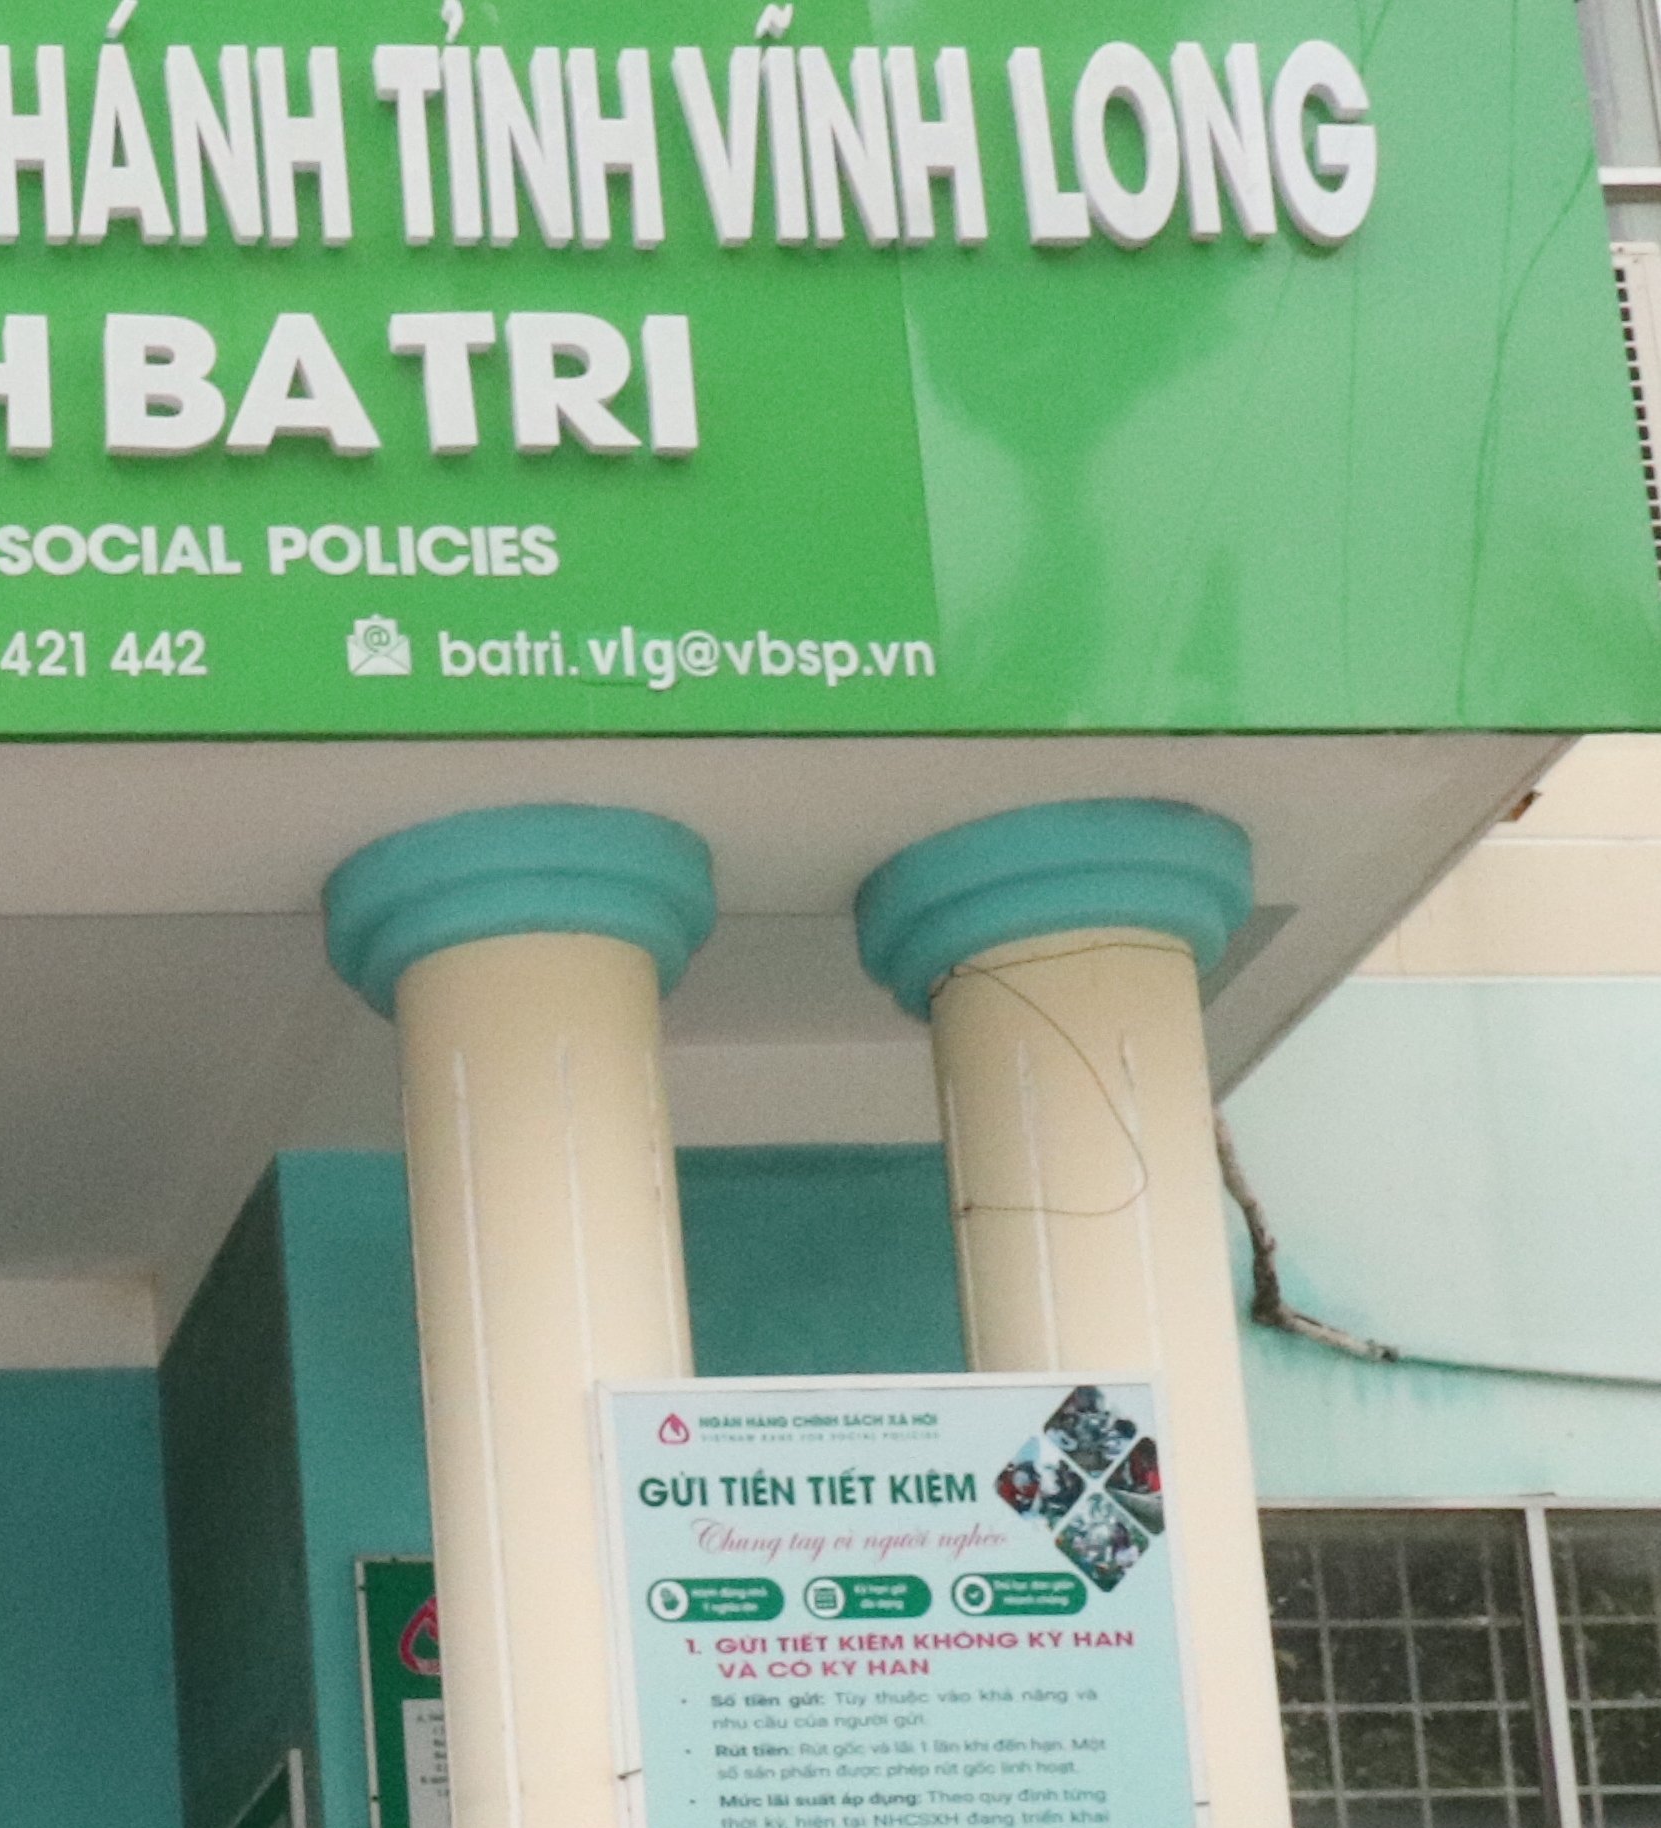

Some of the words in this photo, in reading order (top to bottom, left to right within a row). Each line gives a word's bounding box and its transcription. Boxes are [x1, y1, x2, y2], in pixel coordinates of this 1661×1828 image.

[373, 0, 665, 249] TỈNH
[671, 3, 988, 250] VĨNH
[1006, 39, 1378, 251] LONG
[103, 312, 381, 455] BA
[389, 312, 699, 455] TRI
[268, 525, 559, 577] POLICIES
[0, 629, 87, 678] 421
[110, 629, 209, 678] 442
[438, 625, 937, 691] batri.vlg@vbsp.vn
